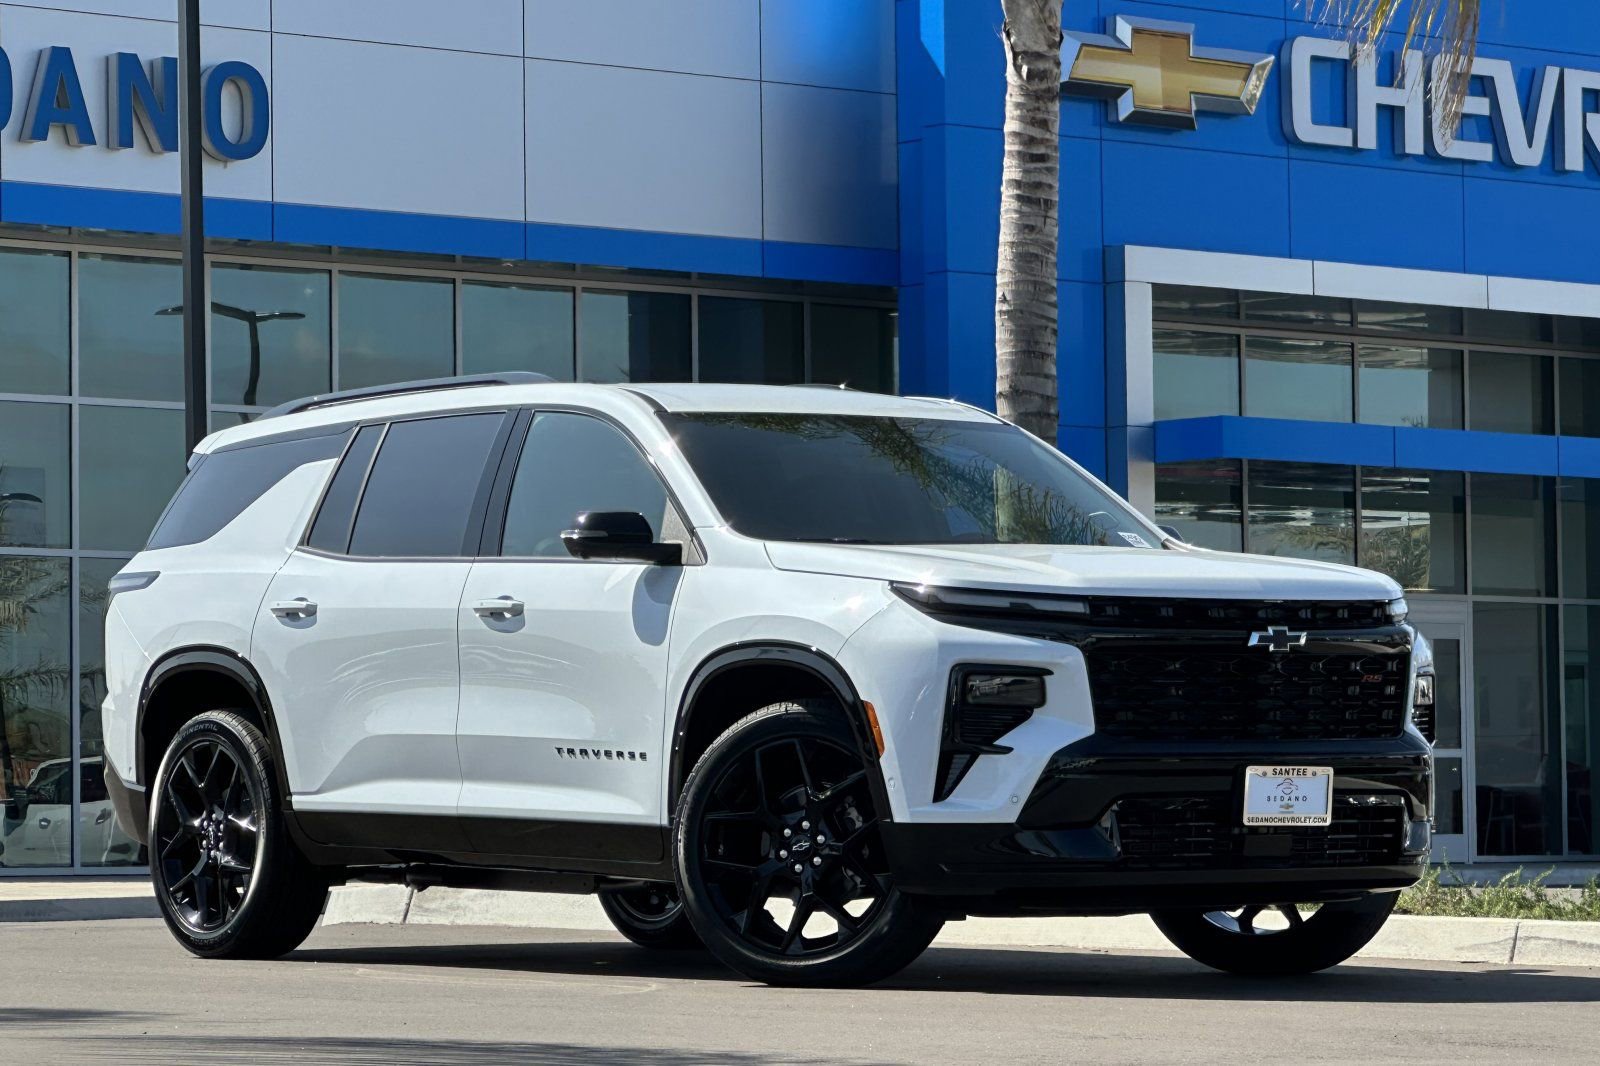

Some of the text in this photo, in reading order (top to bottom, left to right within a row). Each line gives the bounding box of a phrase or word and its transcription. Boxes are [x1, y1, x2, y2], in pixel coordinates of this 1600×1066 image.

[0, 46, 269, 160] ANO
[1361, 674, 1382, 682] RS
[555, 747, 647, 761] TRAVERSE
[1272, 768, 1308, 776] SANTEE
[1247, 816, 1327, 824] SEDANOCHEVROLET.COM
